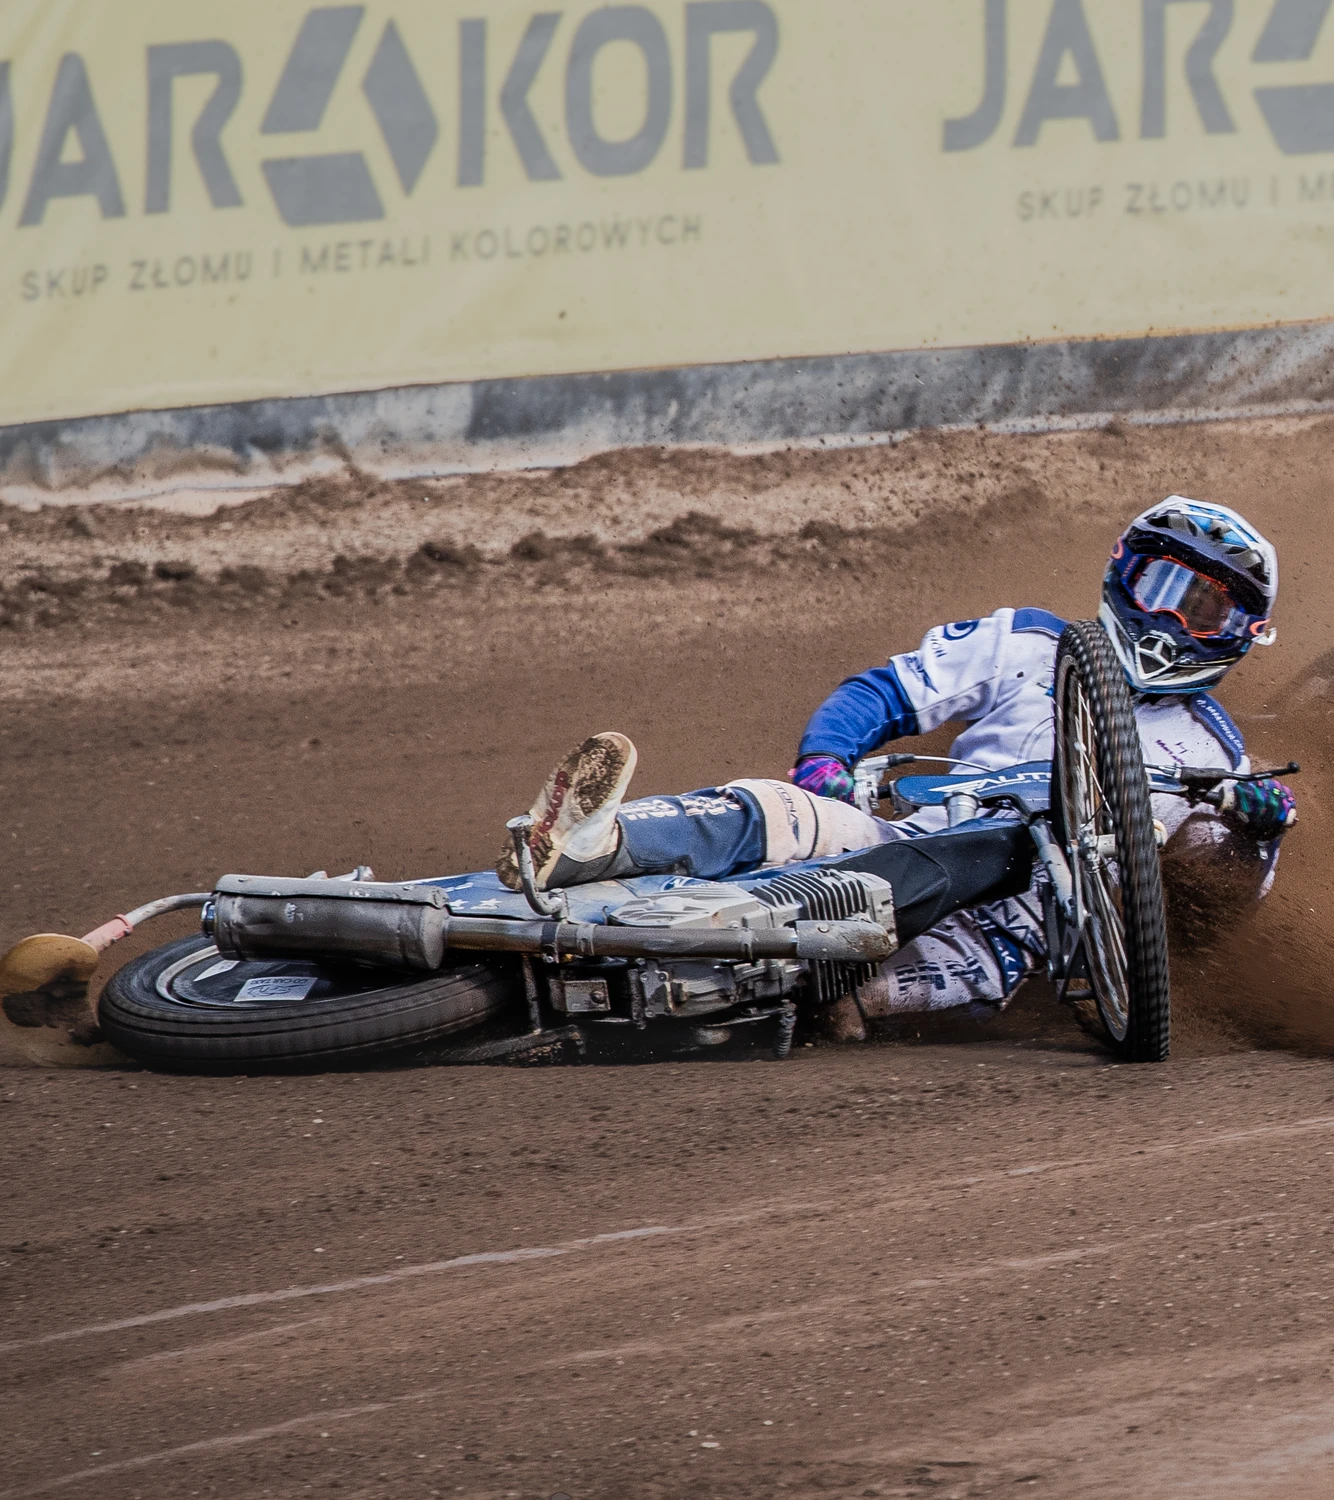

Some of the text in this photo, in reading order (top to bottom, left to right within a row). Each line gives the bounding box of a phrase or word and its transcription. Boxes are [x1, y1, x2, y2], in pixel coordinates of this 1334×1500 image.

[1016, 187, 1104, 222] SKUP
[1126, 177, 1251, 215] ZŁOMU
[21, 265, 108, 302] SKUP
[128, 249, 253, 292] ZŁOMU
[300, 231, 430, 276] METALI
[451, 214, 703, 262] KOLOROWYCH
